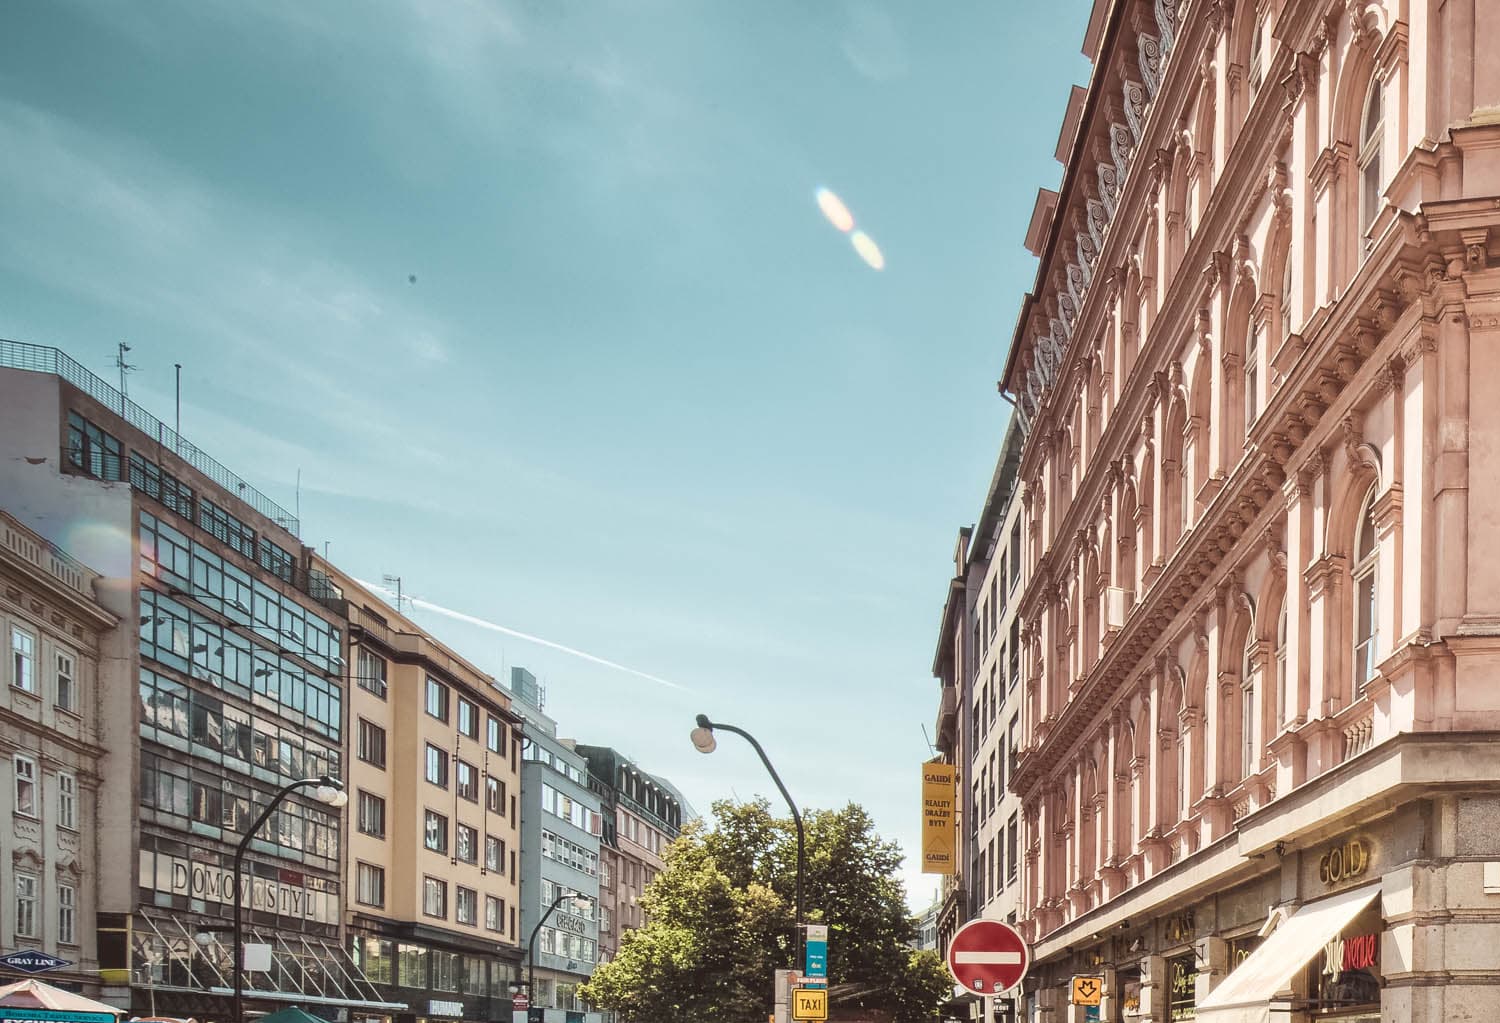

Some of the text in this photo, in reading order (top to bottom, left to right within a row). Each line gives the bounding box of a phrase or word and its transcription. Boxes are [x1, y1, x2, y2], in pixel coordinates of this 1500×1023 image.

[925, 800, 950, 808] REALITY
[1319, 841, 1364, 884] GOLD
[174, 862, 250, 904] DOMOV
[267, 884, 314, 916] STYL
[7, 957, 57, 967] GRAY LINE
[800, 999, 821, 1011] TAXI
